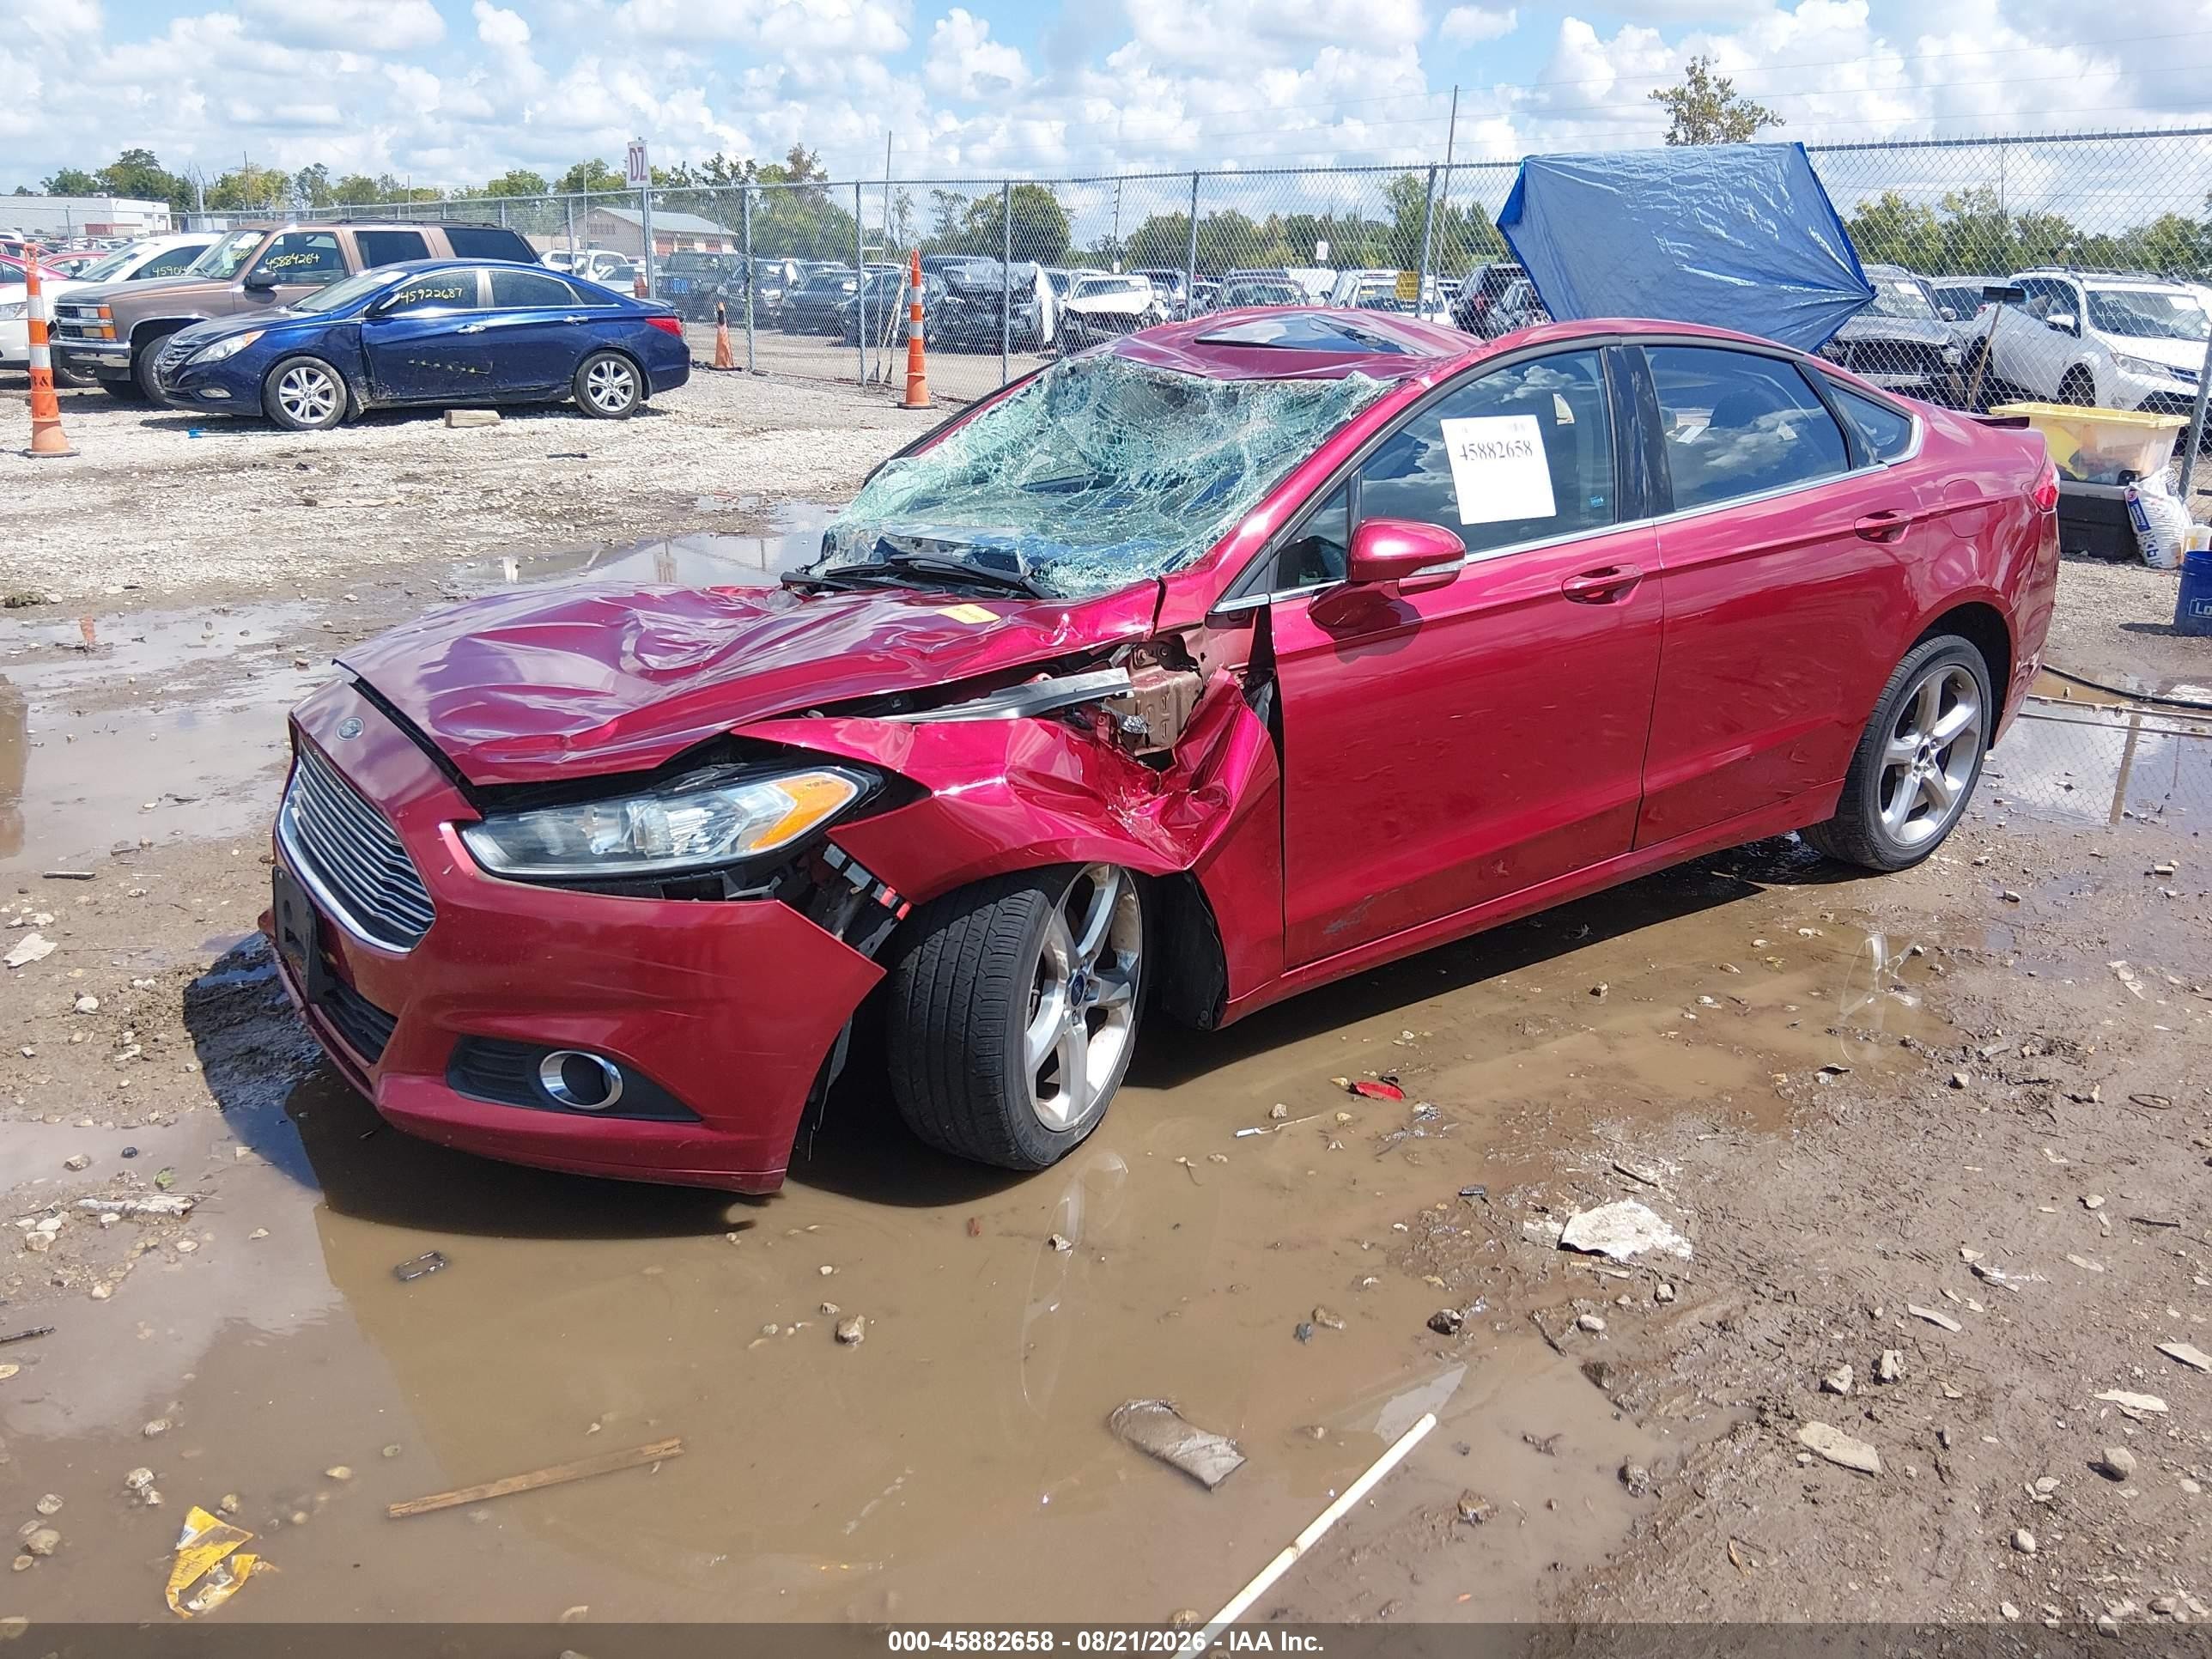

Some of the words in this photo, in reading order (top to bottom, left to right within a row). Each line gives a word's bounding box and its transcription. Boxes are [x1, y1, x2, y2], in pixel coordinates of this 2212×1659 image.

[265, 252, 320, 270] 45884264
[400, 288, 463, 306] 45922687
[1459, 440, 1533, 461] 45882658
